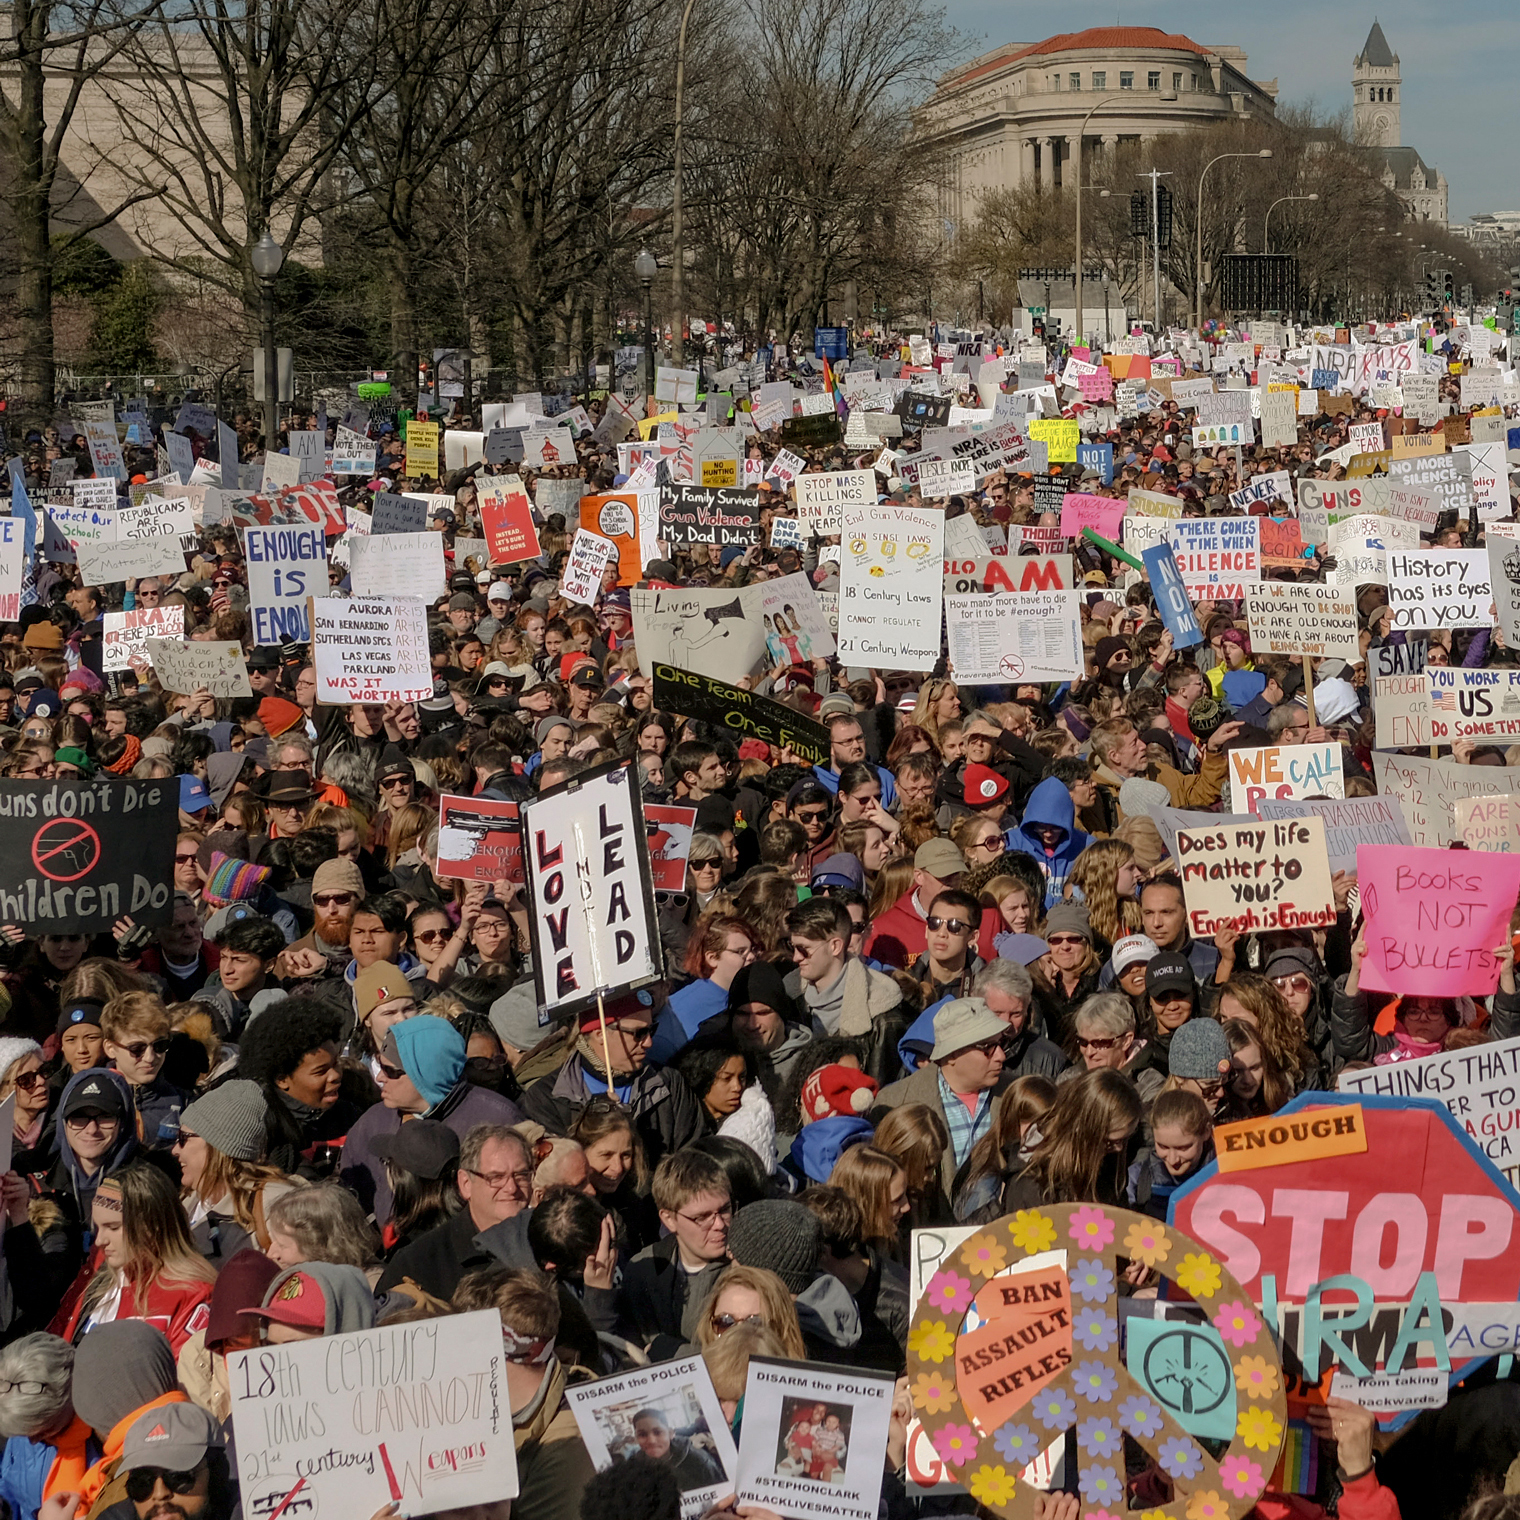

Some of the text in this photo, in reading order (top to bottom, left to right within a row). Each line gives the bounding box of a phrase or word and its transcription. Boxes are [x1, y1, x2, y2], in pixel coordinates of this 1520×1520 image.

[957, 342, 982, 357] NRA
[1391, 456, 1453, 474] NO MORE
[805, 476, 864, 489] STOP MASS
[662, 486, 759, 508] My Family Survived
[807, 489, 862, 502] KILLINGS
[660, 504, 752, 527] Gun Violence
[801, 506, 821, 517] BAN
[249, 529, 326, 561] ENOUGH
[663, 525, 758, 545] My Dad Didn't
[1392, 556, 1469, 580] History
[1390, 581, 1490, 602] has its eyes
[348, 604, 392, 615] AURORA
[1395, 606, 1428, 626] on
[315, 617, 389, 631] SAN BERNARDINO
[342, 652, 361, 660] LAS
[343, 665, 396, 674] PARKLAND
[1428, 671, 1454, 686] YOU
[1463, 672, 1499, 685] WORK
[1459, 689, 1492, 717] US
[1432, 721, 1448, 737] DO
[1232, 748, 1340, 790] WE CALL
[43, 782, 161, 817] don't Die
[1179, 825, 1309, 853] Does my life
[1183, 857, 1302, 881] matter to
[131, 874, 169, 912] Do
[599, 804, 635, 965] LEAD
[1231, 878, 1284, 902] you?
[535, 830, 580, 999] LOVE
[1419, 904, 1488, 930] NOT
[1224, 1115, 1355, 1152] ENOUGH
[1192, 1183, 1513, 1300] STOP
[1000, 1281, 1063, 1305] BAN
[959, 1310, 1070, 1375] ASSAULT
[325, 1323, 438, 1394] century
[757, 1372, 885, 1398] DISARM the POLICE
[979, 1348, 1071, 1403] RIFLES
[1357, 1375, 1438, 1388] from taking
[353, 1373, 490, 1435] CANNOT
[1357, 1395, 1439, 1408] backwards.
[296, 1449, 375, 1478] century
[755, 1477, 860, 1500] #STEPHONCLARK
[740, 1491, 872, 1519] #BLACKLIVESMATTER
